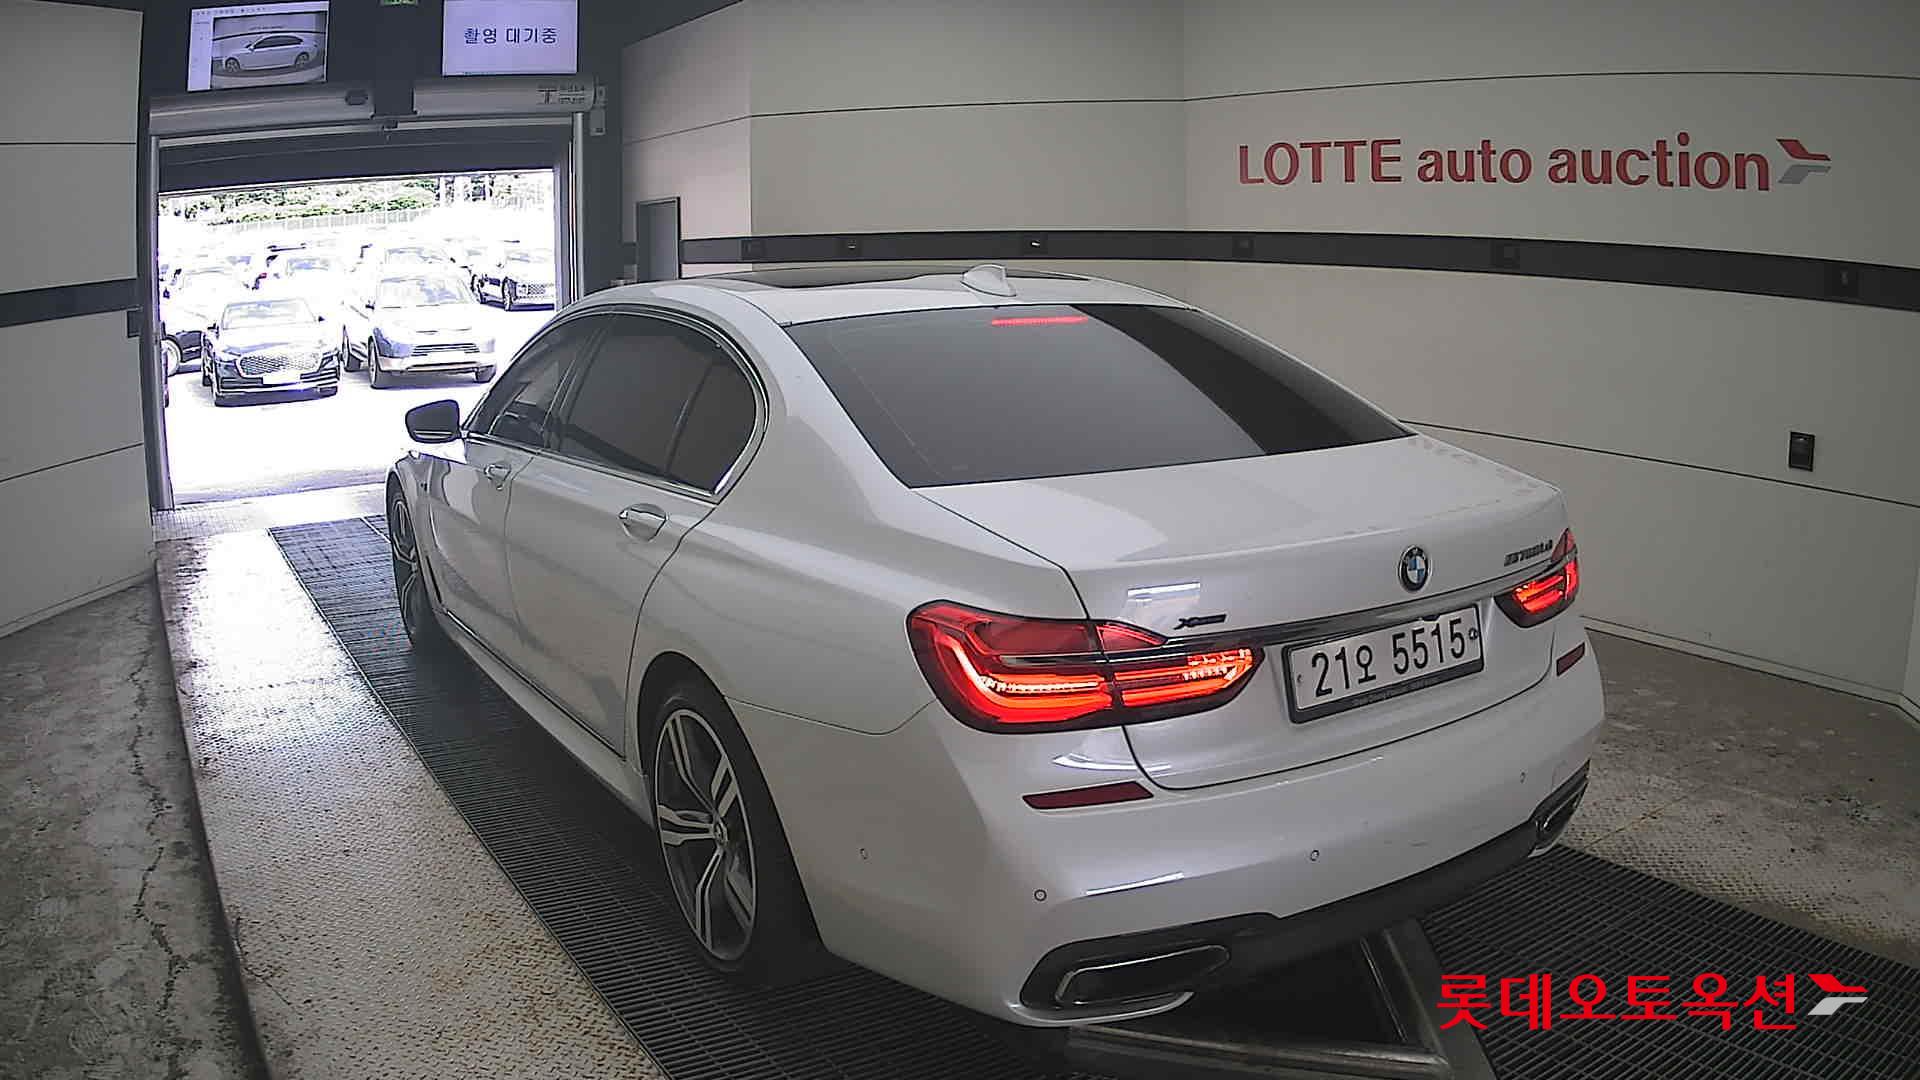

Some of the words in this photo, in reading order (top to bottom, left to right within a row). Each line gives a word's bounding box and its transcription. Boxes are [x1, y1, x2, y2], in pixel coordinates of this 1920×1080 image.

[464, 27, 497, 44] 촬영
[506, 27, 558, 44] 대기중
[1239, 138, 1401, 185] LOTTE
[1417, 140, 1531, 182] auto
[1548, 132, 1770, 190] auction
[1311, 645, 1377, 698] 21오
[1391, 617, 1465, 676] 5515
